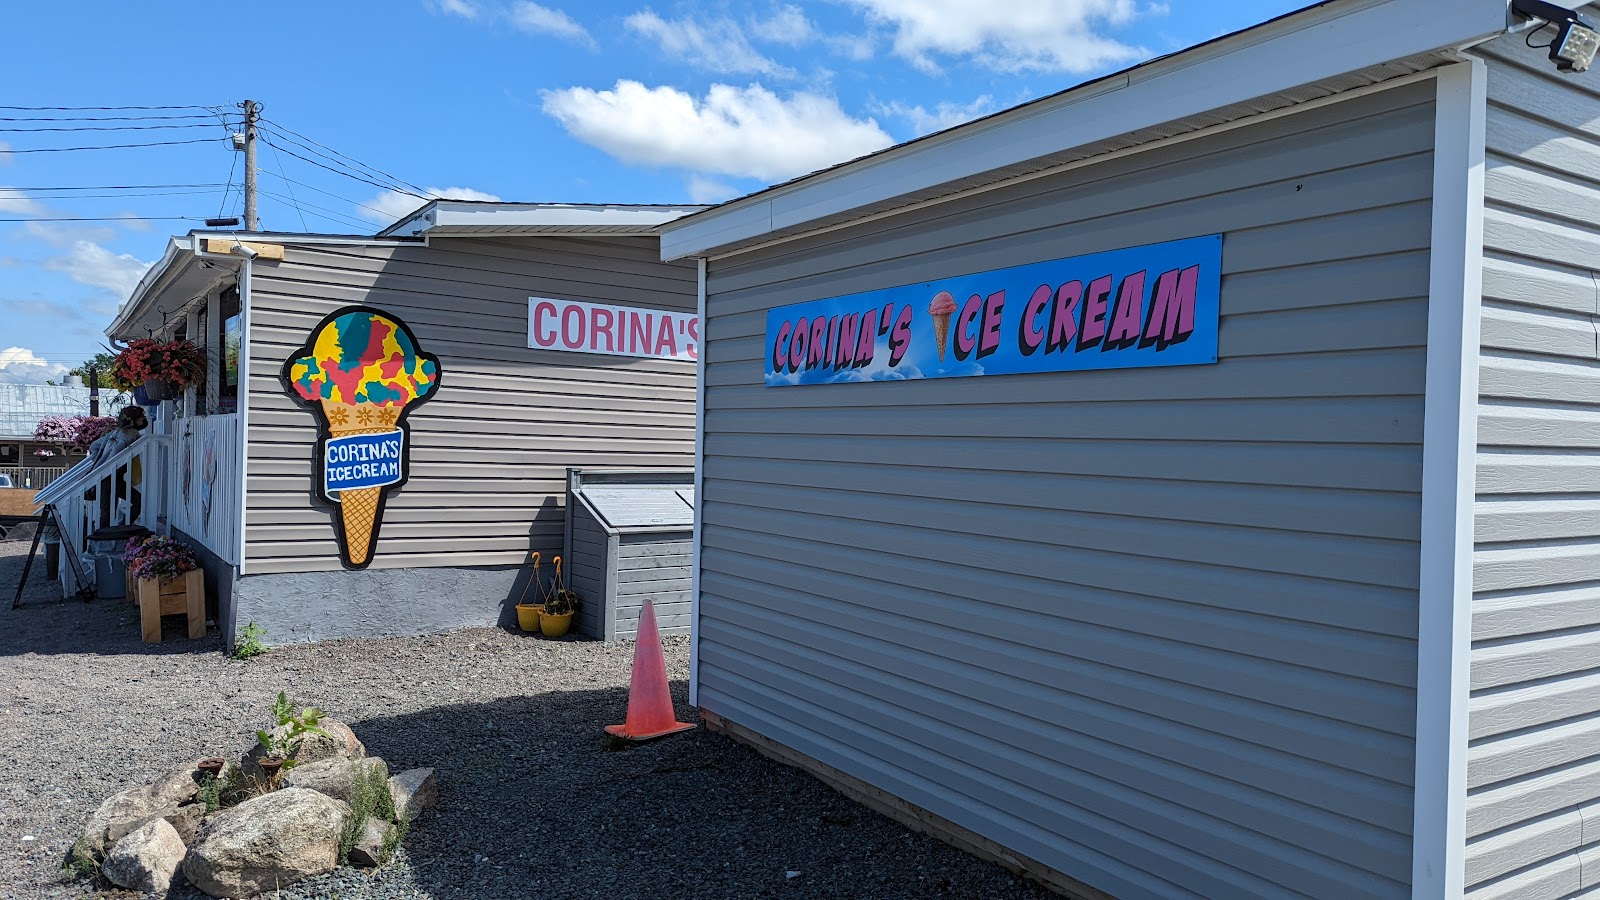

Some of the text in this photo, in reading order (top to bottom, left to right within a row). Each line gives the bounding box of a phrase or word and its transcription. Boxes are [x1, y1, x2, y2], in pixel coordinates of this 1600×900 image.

[772, 302, 913, 374] CORINA'S
[1018, 264, 1200, 357] CREAM
[328, 440, 399, 464] CORINA'S
[328, 462, 398, 482] ICECREAM
